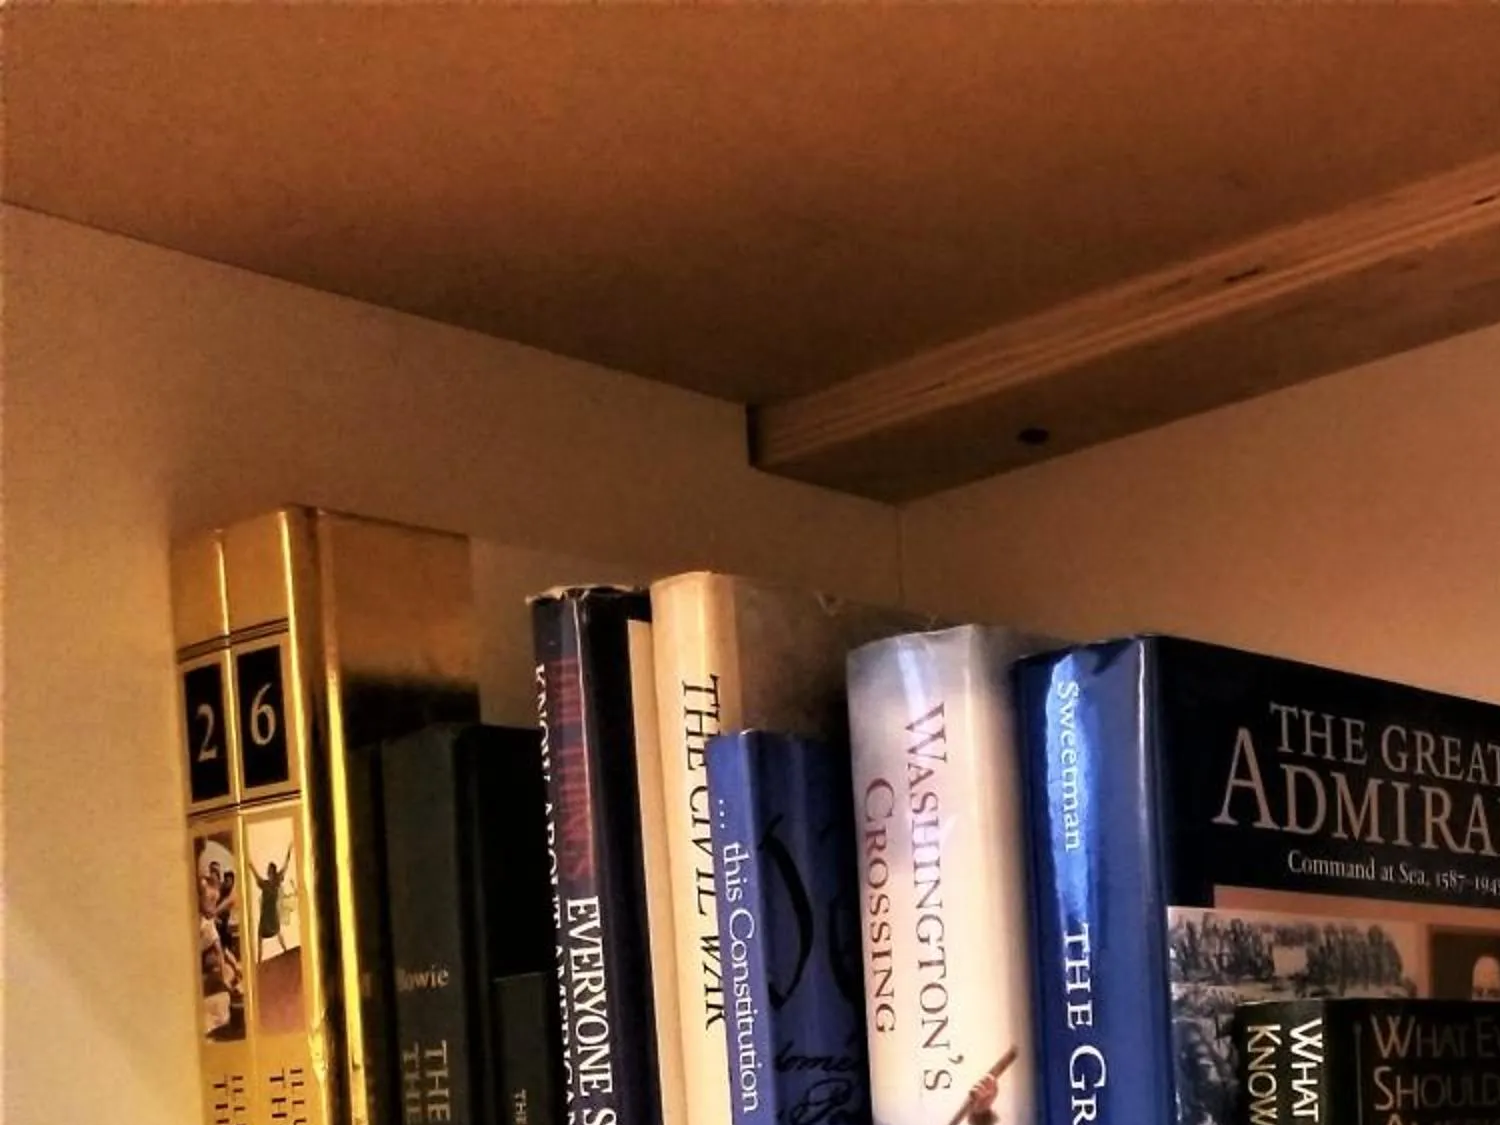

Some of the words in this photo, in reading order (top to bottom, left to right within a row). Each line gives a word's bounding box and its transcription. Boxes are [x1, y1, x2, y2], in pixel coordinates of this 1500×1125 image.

[197, 704, 219, 762] 2
[250, 682, 277, 746] 6
[681, 673, 721, 772] THE
[1269, 702, 1369, 766] THE
[689, 784, 718, 917] CIVIL
[722, 841, 749, 902] this
[1287, 849, 1376, 882] Command
[1380, 863, 1396, 883] at
[863, 776, 896, 1034] CROSSING
[905, 701, 965, 1092] WASHINGTON'S
[567, 895, 613, 1096] EVERYONE
[729, 908, 763, 1114] Constitution
[1063, 921, 1093, 1030] THE
[1289, 1016, 1325, 1123] WHAT
[1370, 1014, 1468, 1059] WHAT
[403, 1041, 424, 1125] THE
[424, 1039, 451, 1123] THE
[513, 1088, 529, 1125] THE
